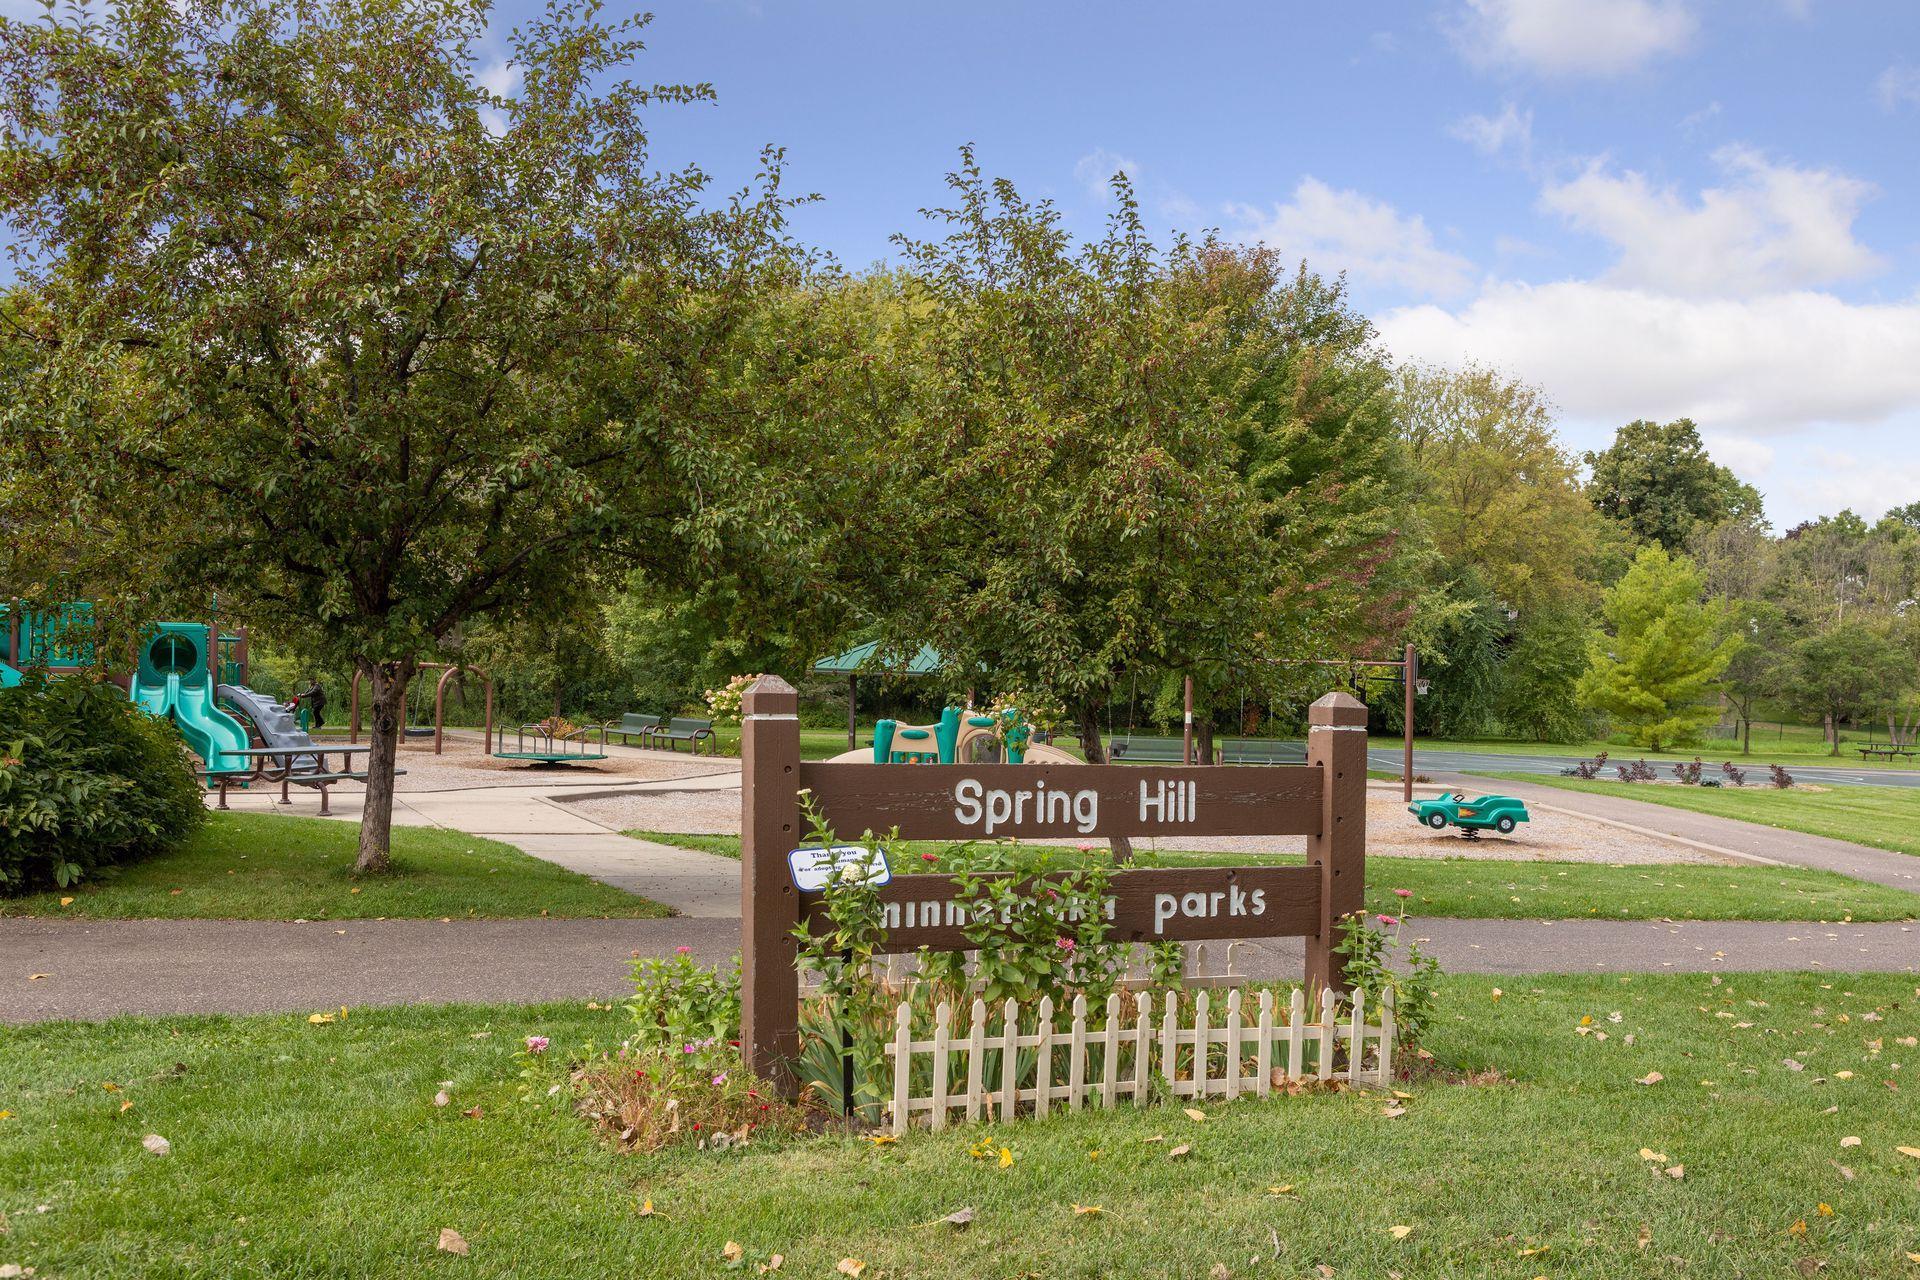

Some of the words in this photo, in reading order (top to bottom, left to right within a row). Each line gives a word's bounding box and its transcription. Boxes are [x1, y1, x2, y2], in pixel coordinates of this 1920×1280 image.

[955, 778, 1098, 835] Spring
[1139, 779, 1196, 823] Hill
[811, 851, 838, 859] Tha
[1154, 884, 1266, 934] parks
